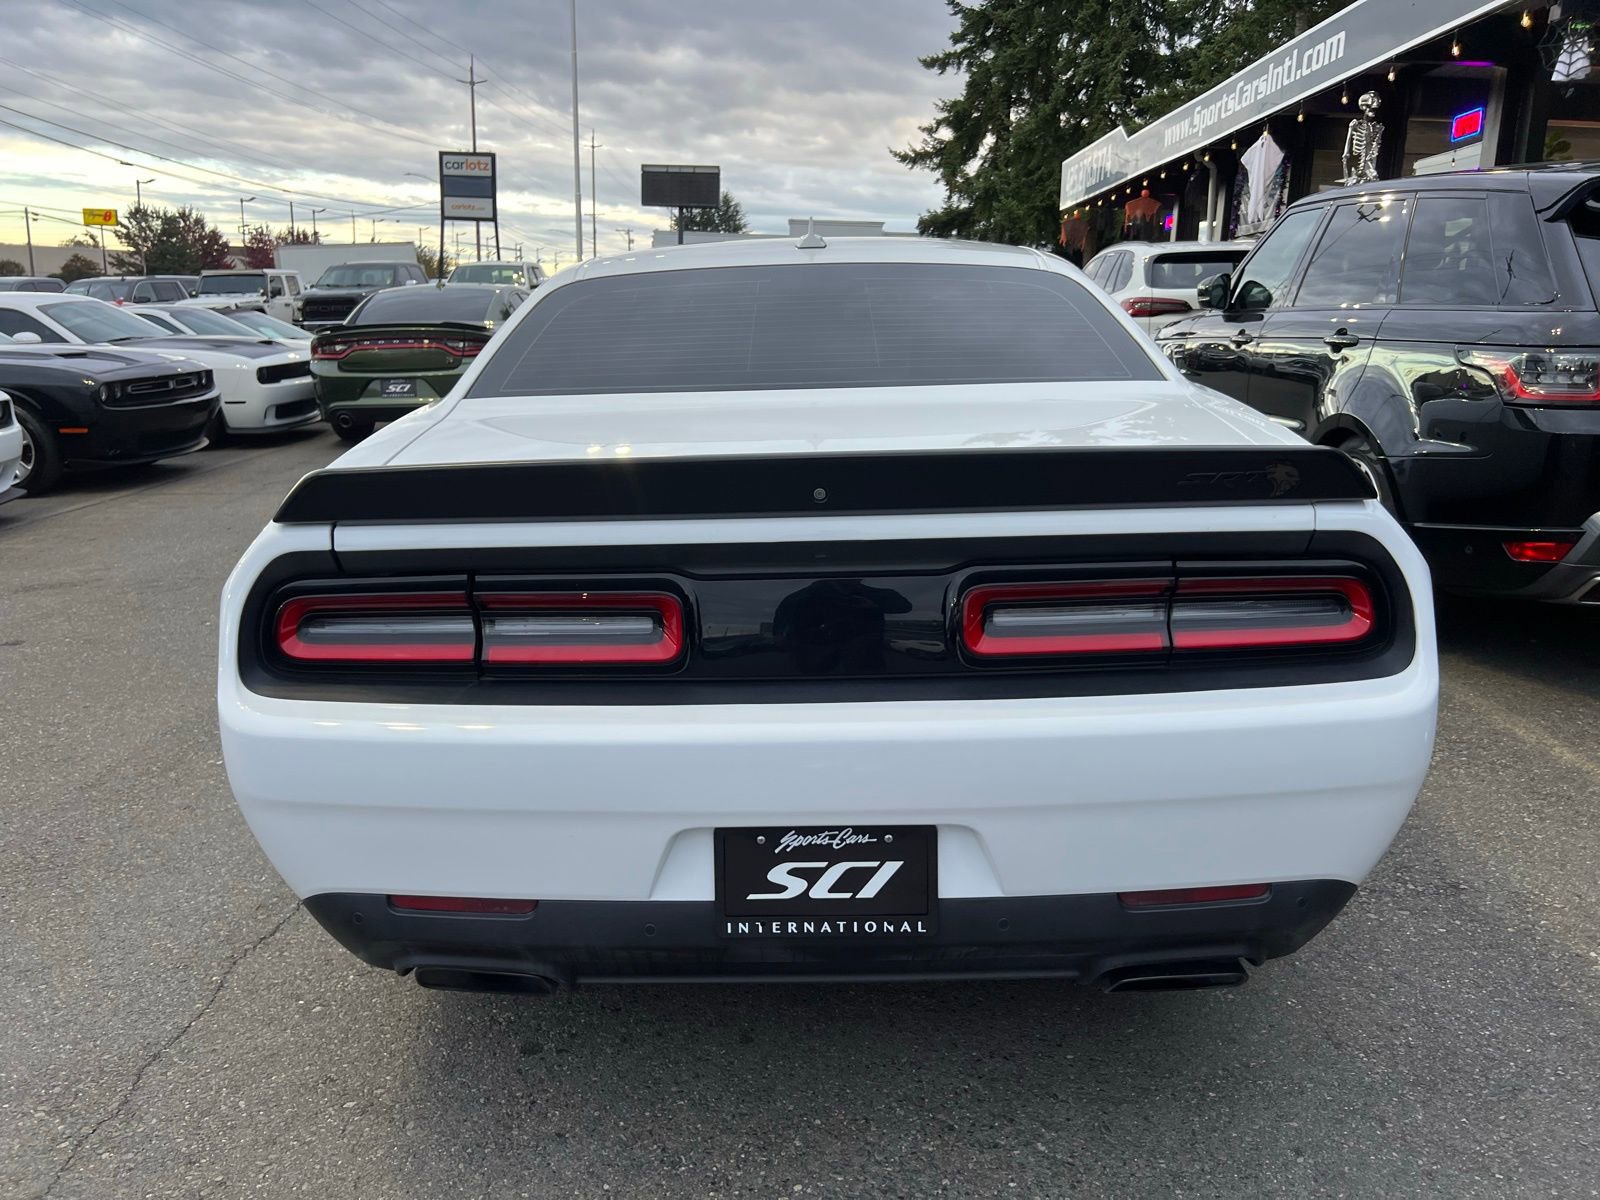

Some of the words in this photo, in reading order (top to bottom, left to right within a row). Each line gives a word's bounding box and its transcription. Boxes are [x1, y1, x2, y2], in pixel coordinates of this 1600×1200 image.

[1164, 30, 1346, 148] www.SportsCarsIntl.com
[444, 158, 489, 172] carlotz
[385, 383, 412, 393] SCI
[774, 830, 837, 854] Sports
[832, 828, 877, 849] Cars
[746, 860, 904, 900] SCI
[727, 920, 927, 934] INTERNATIONAL
